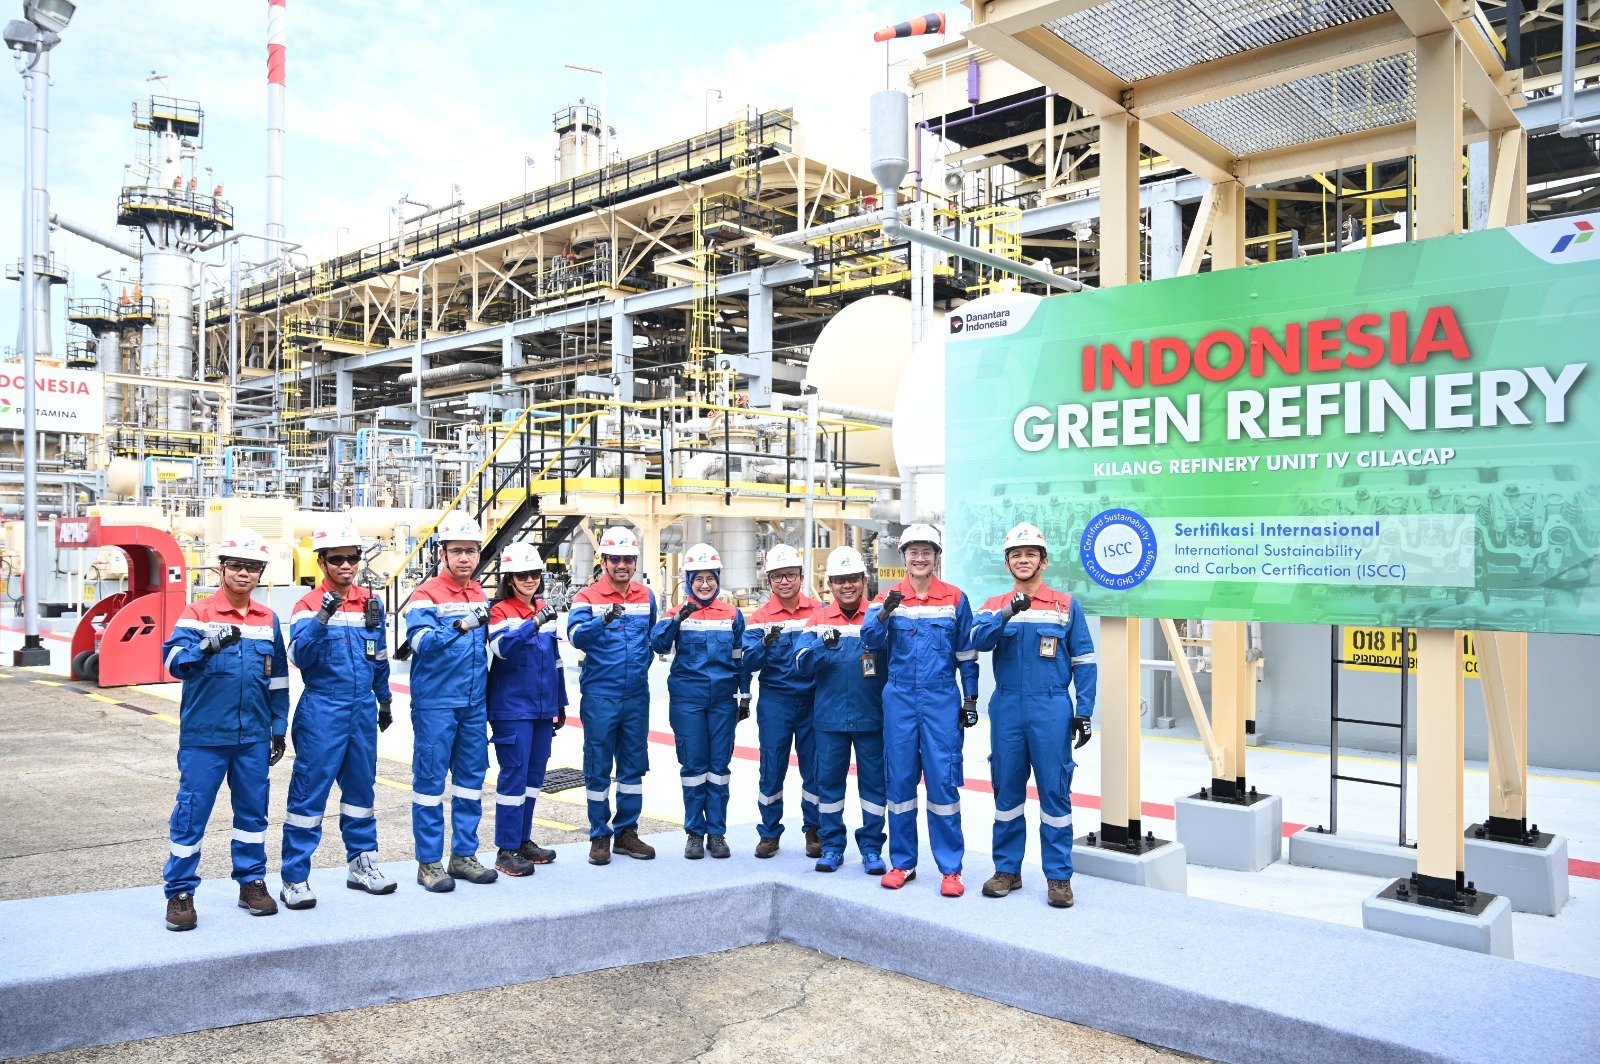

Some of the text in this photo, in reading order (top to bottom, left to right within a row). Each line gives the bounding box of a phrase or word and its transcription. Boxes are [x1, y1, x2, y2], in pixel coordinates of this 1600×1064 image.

[966, 309, 1010, 322] Danantara
[966, 319, 1007, 331] Indonesia
[1081, 305, 1471, 392] INDONESIA
[16, 407, 77, 418] PTAMINA
[1013, 362, 1588, 452] GREEN REFINERY
[1093, 447, 1456, 477] KILANG REFINERY UNIT IV CILACAP
[1084, 513, 1149, 550] Certified Sustainability
[1174, 521, 1380, 537] Sertifikasi Internasional
[1103, 541, 1133, 558] ISCC
[1174, 543, 1363, 560] International Sustainability
[1086, 550, 1154, 587] Certified GHG Savings
[1174, 562, 1406, 580] and Carbon Certification (ISCC)
[1353, 629, 1386, 651] 018
